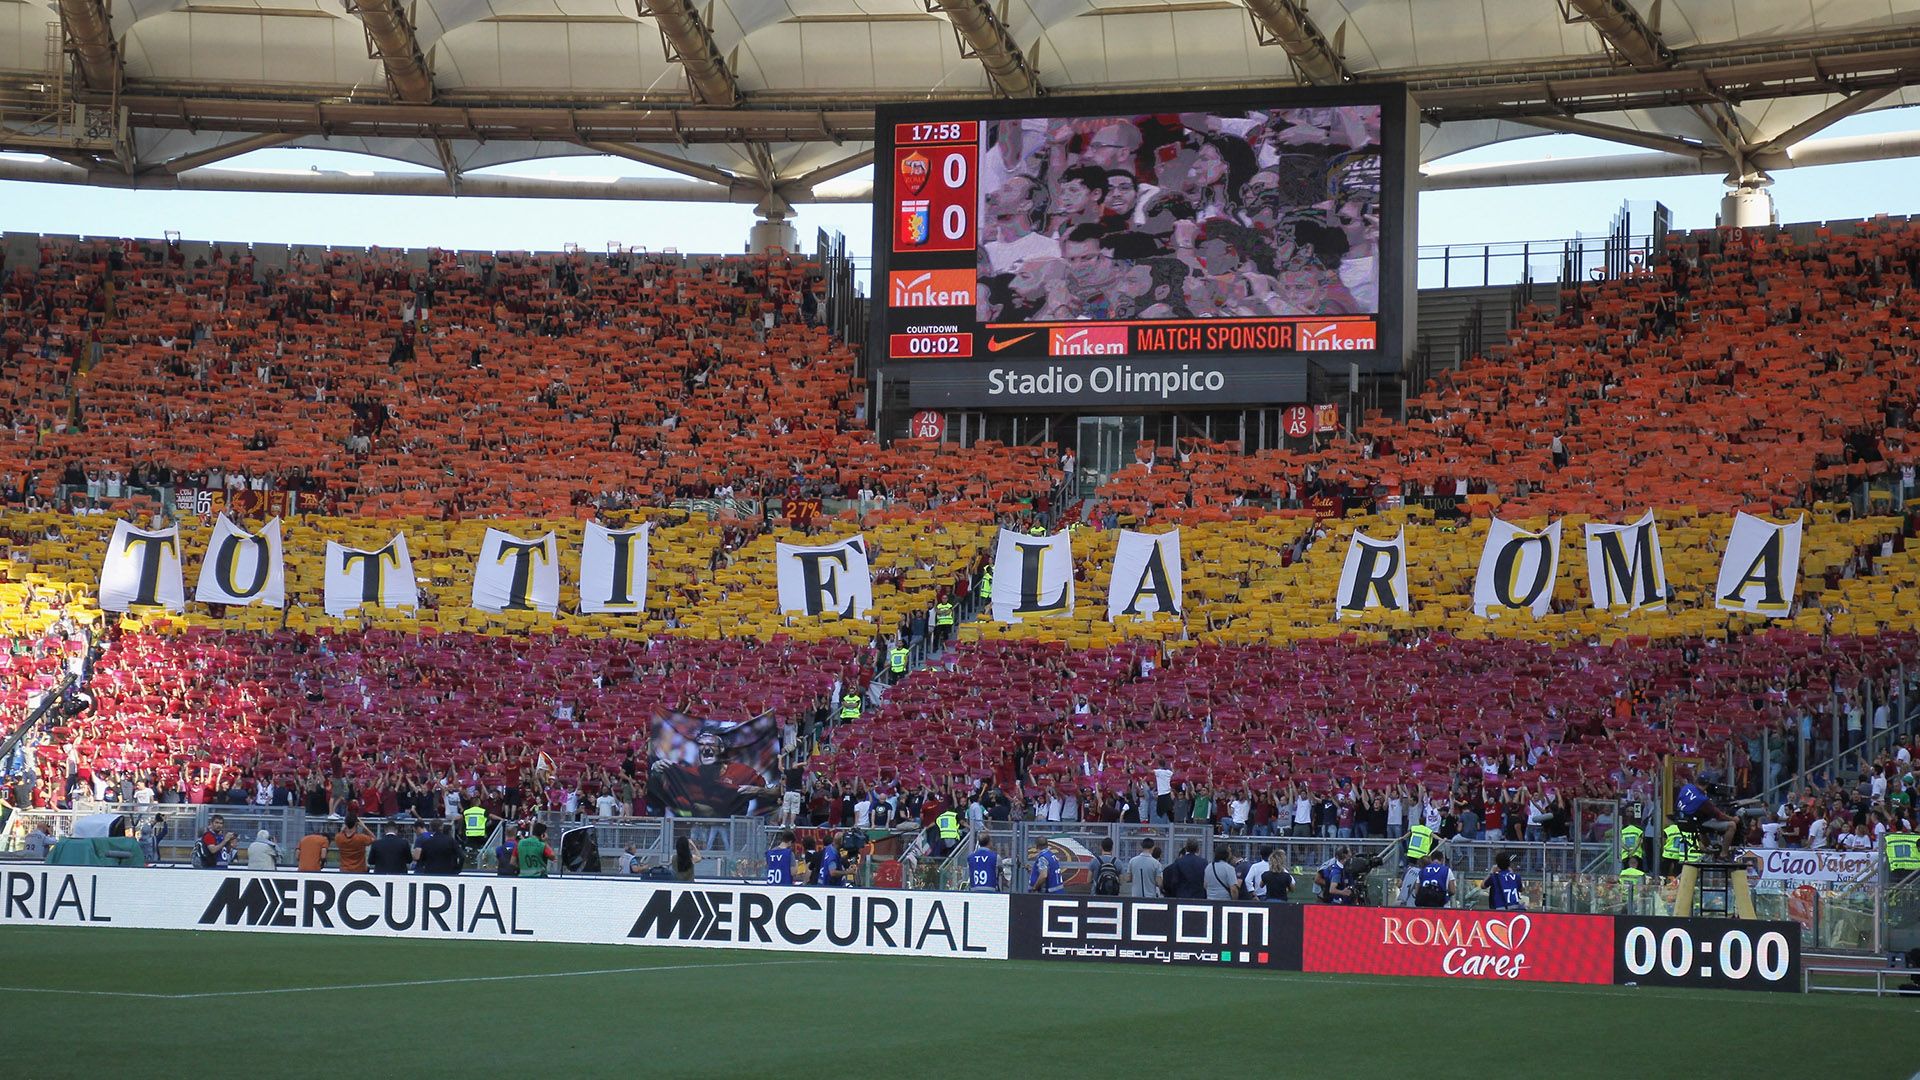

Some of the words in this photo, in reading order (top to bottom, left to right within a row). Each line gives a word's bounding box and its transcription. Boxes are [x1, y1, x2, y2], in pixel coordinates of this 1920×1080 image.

[912, 124, 960, 140] 17:58
[943, 153, 967, 188] 0
[943, 204, 966, 240] 0
[896, 276, 970, 307] linkem
[907, 325, 958, 334] COUNTDOWN
[1137, 327, 1201, 350] MATCH
[1207, 325, 1292, 349] SPONSOR
[1303, 328, 1374, 351] linkem
[909, 337, 959, 354] 00:02
[1055, 333, 1124, 355] linkem
[988, 366, 1083, 395] Stadio
[1089, 364, 1225, 398] Olimpico
[921, 411, 937, 424] 20
[1291, 407, 1306, 420] 19
[1316, 410, 1337, 426] 10
[919, 425, 939, 438] AD
[1290, 421, 1307, 434] AS
[786, 502, 820, 518] 27%
[124, 531, 641, 611] TOTTI
[1012, 539, 1181, 618] LA
[1341, 522, 1788, 612] ROMA
[1685, 788, 1697, 800] TV
[1767, 851, 1816, 875] Ciao
[767, 869, 782, 884] 50
[973, 870, 988, 885] 69
[1503, 873, 1516, 881] TV
[0, 872, 111, 921] RIAL
[198, 877, 533, 935] MERCURIAL
[1504, 888, 1519, 903] 71
[626, 889, 987, 952] MERCURIAL
[1382, 917, 1490, 948] ROMA
[1042, 943, 1117, 957] international
[1119, 946, 1170, 963] security
[1173, 950, 1218, 962] service
[1442, 947, 1531, 978] Cares
[1625, 926, 1790, 981] 00:00
